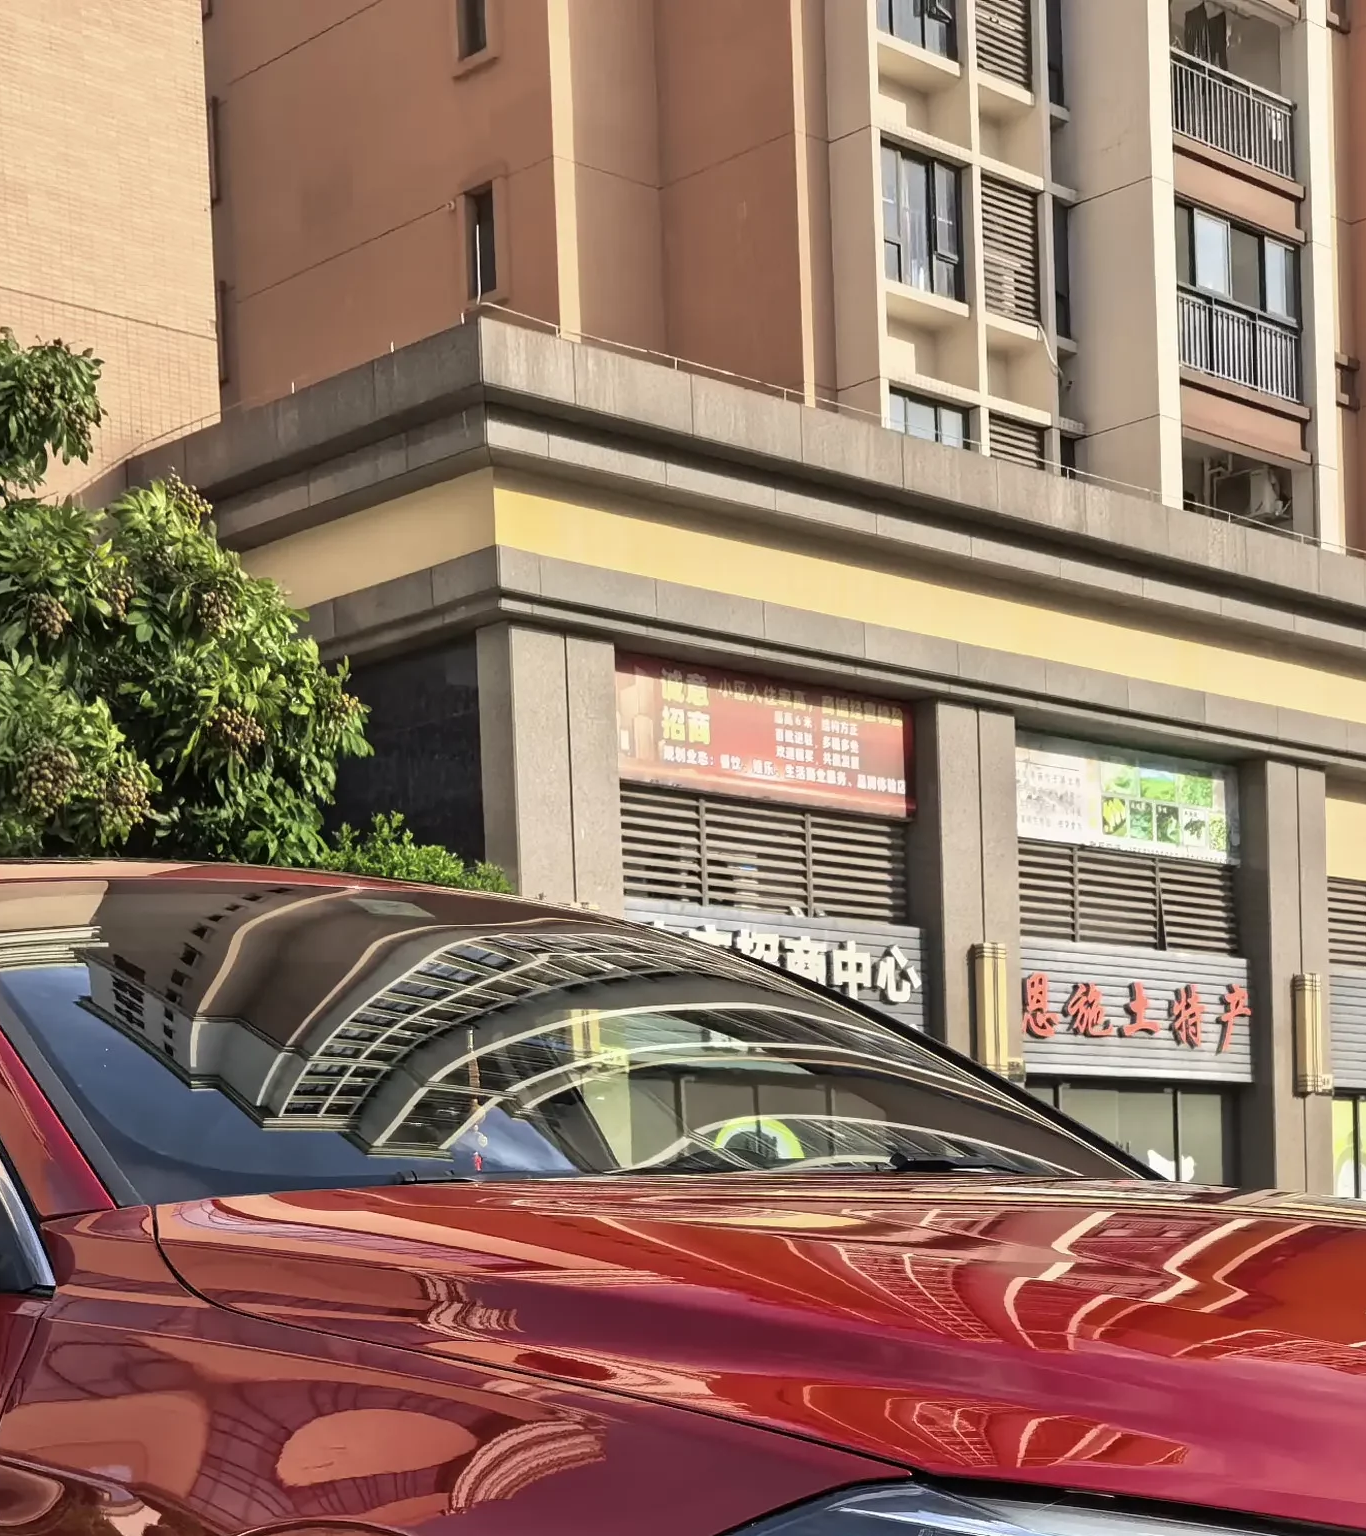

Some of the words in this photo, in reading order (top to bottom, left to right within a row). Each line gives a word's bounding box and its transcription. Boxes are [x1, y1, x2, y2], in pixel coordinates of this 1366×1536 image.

[661, 668, 710, 706] 诚意
[661, 706, 711, 745] 招商
[1021, 972, 1252, 1055] 恩施土特产
